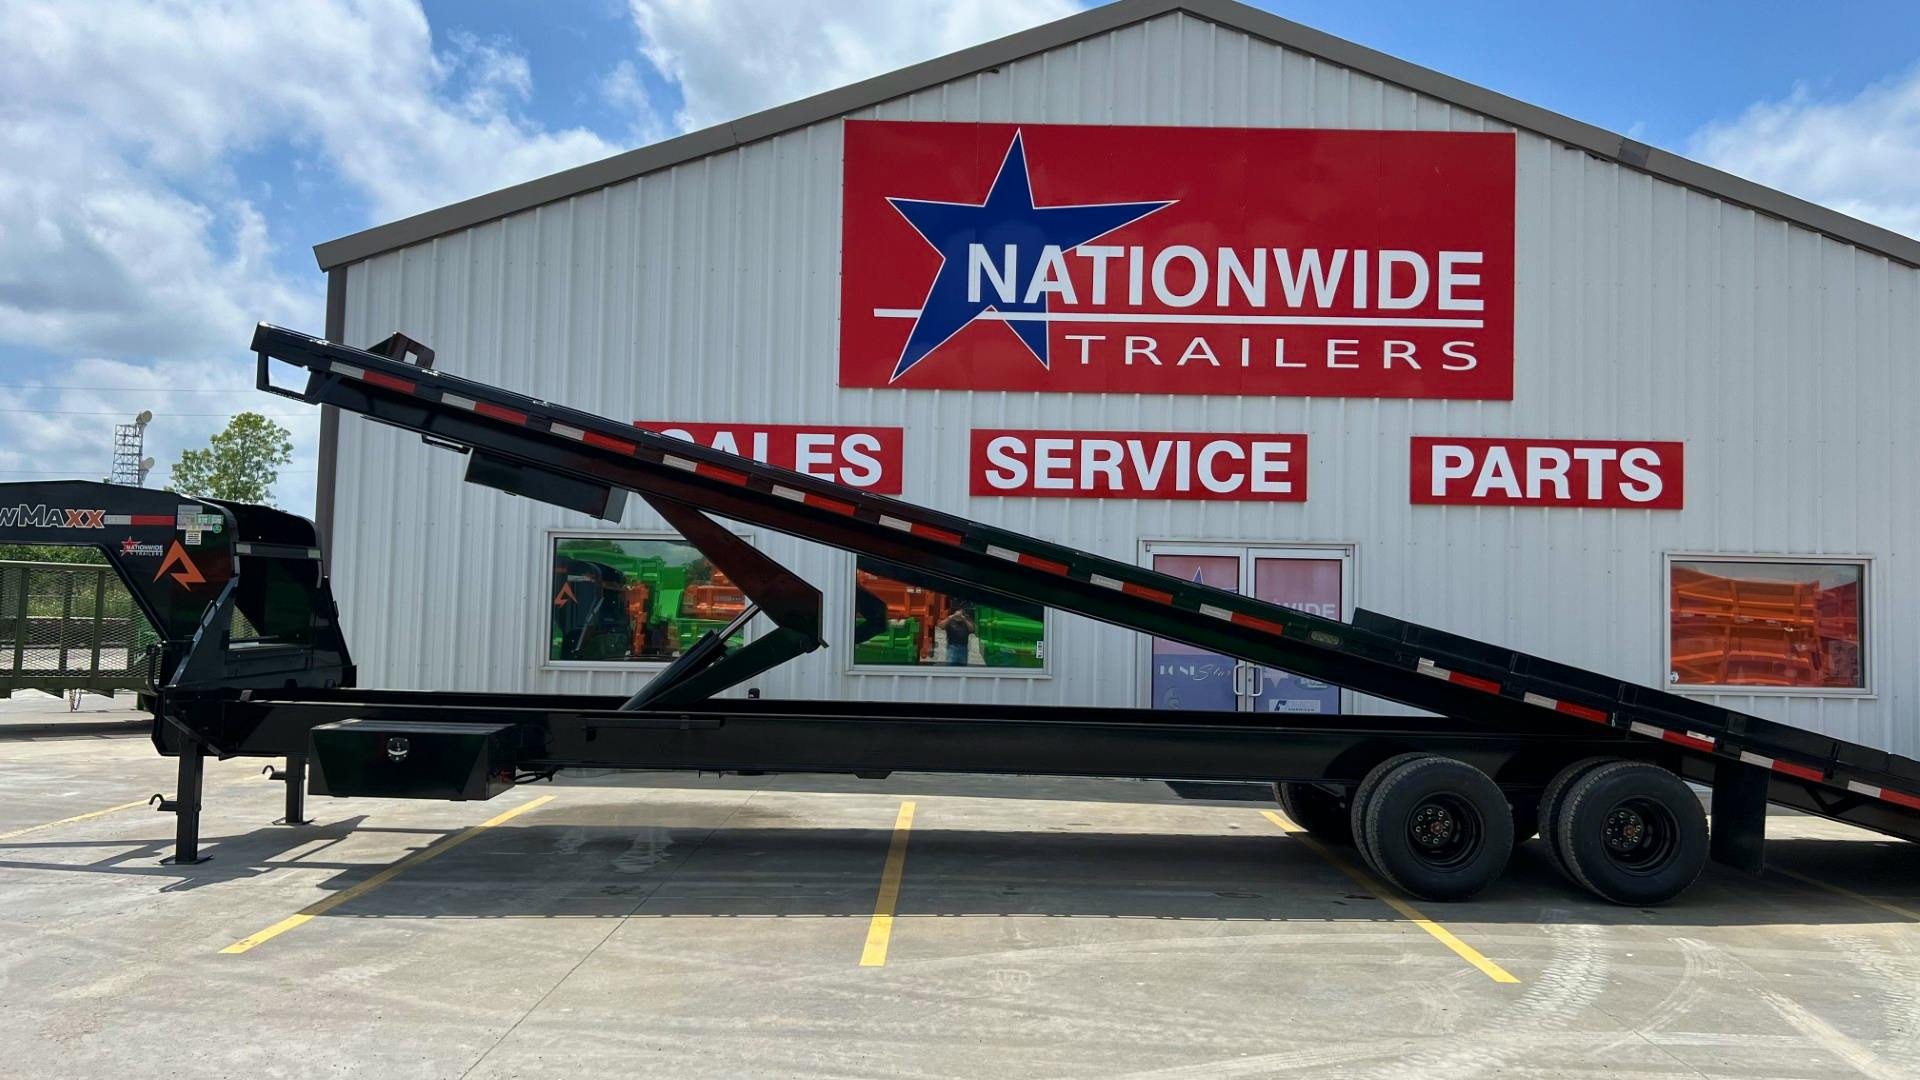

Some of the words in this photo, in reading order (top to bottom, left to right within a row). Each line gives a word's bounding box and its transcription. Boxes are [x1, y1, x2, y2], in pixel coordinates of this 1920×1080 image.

[967, 243, 1484, 312] NATIONWIDE
[1065, 334, 1478, 372] TRAILERS
[985, 436, 1292, 493] SERVICE
[1431, 445, 1663, 502] PARTS
